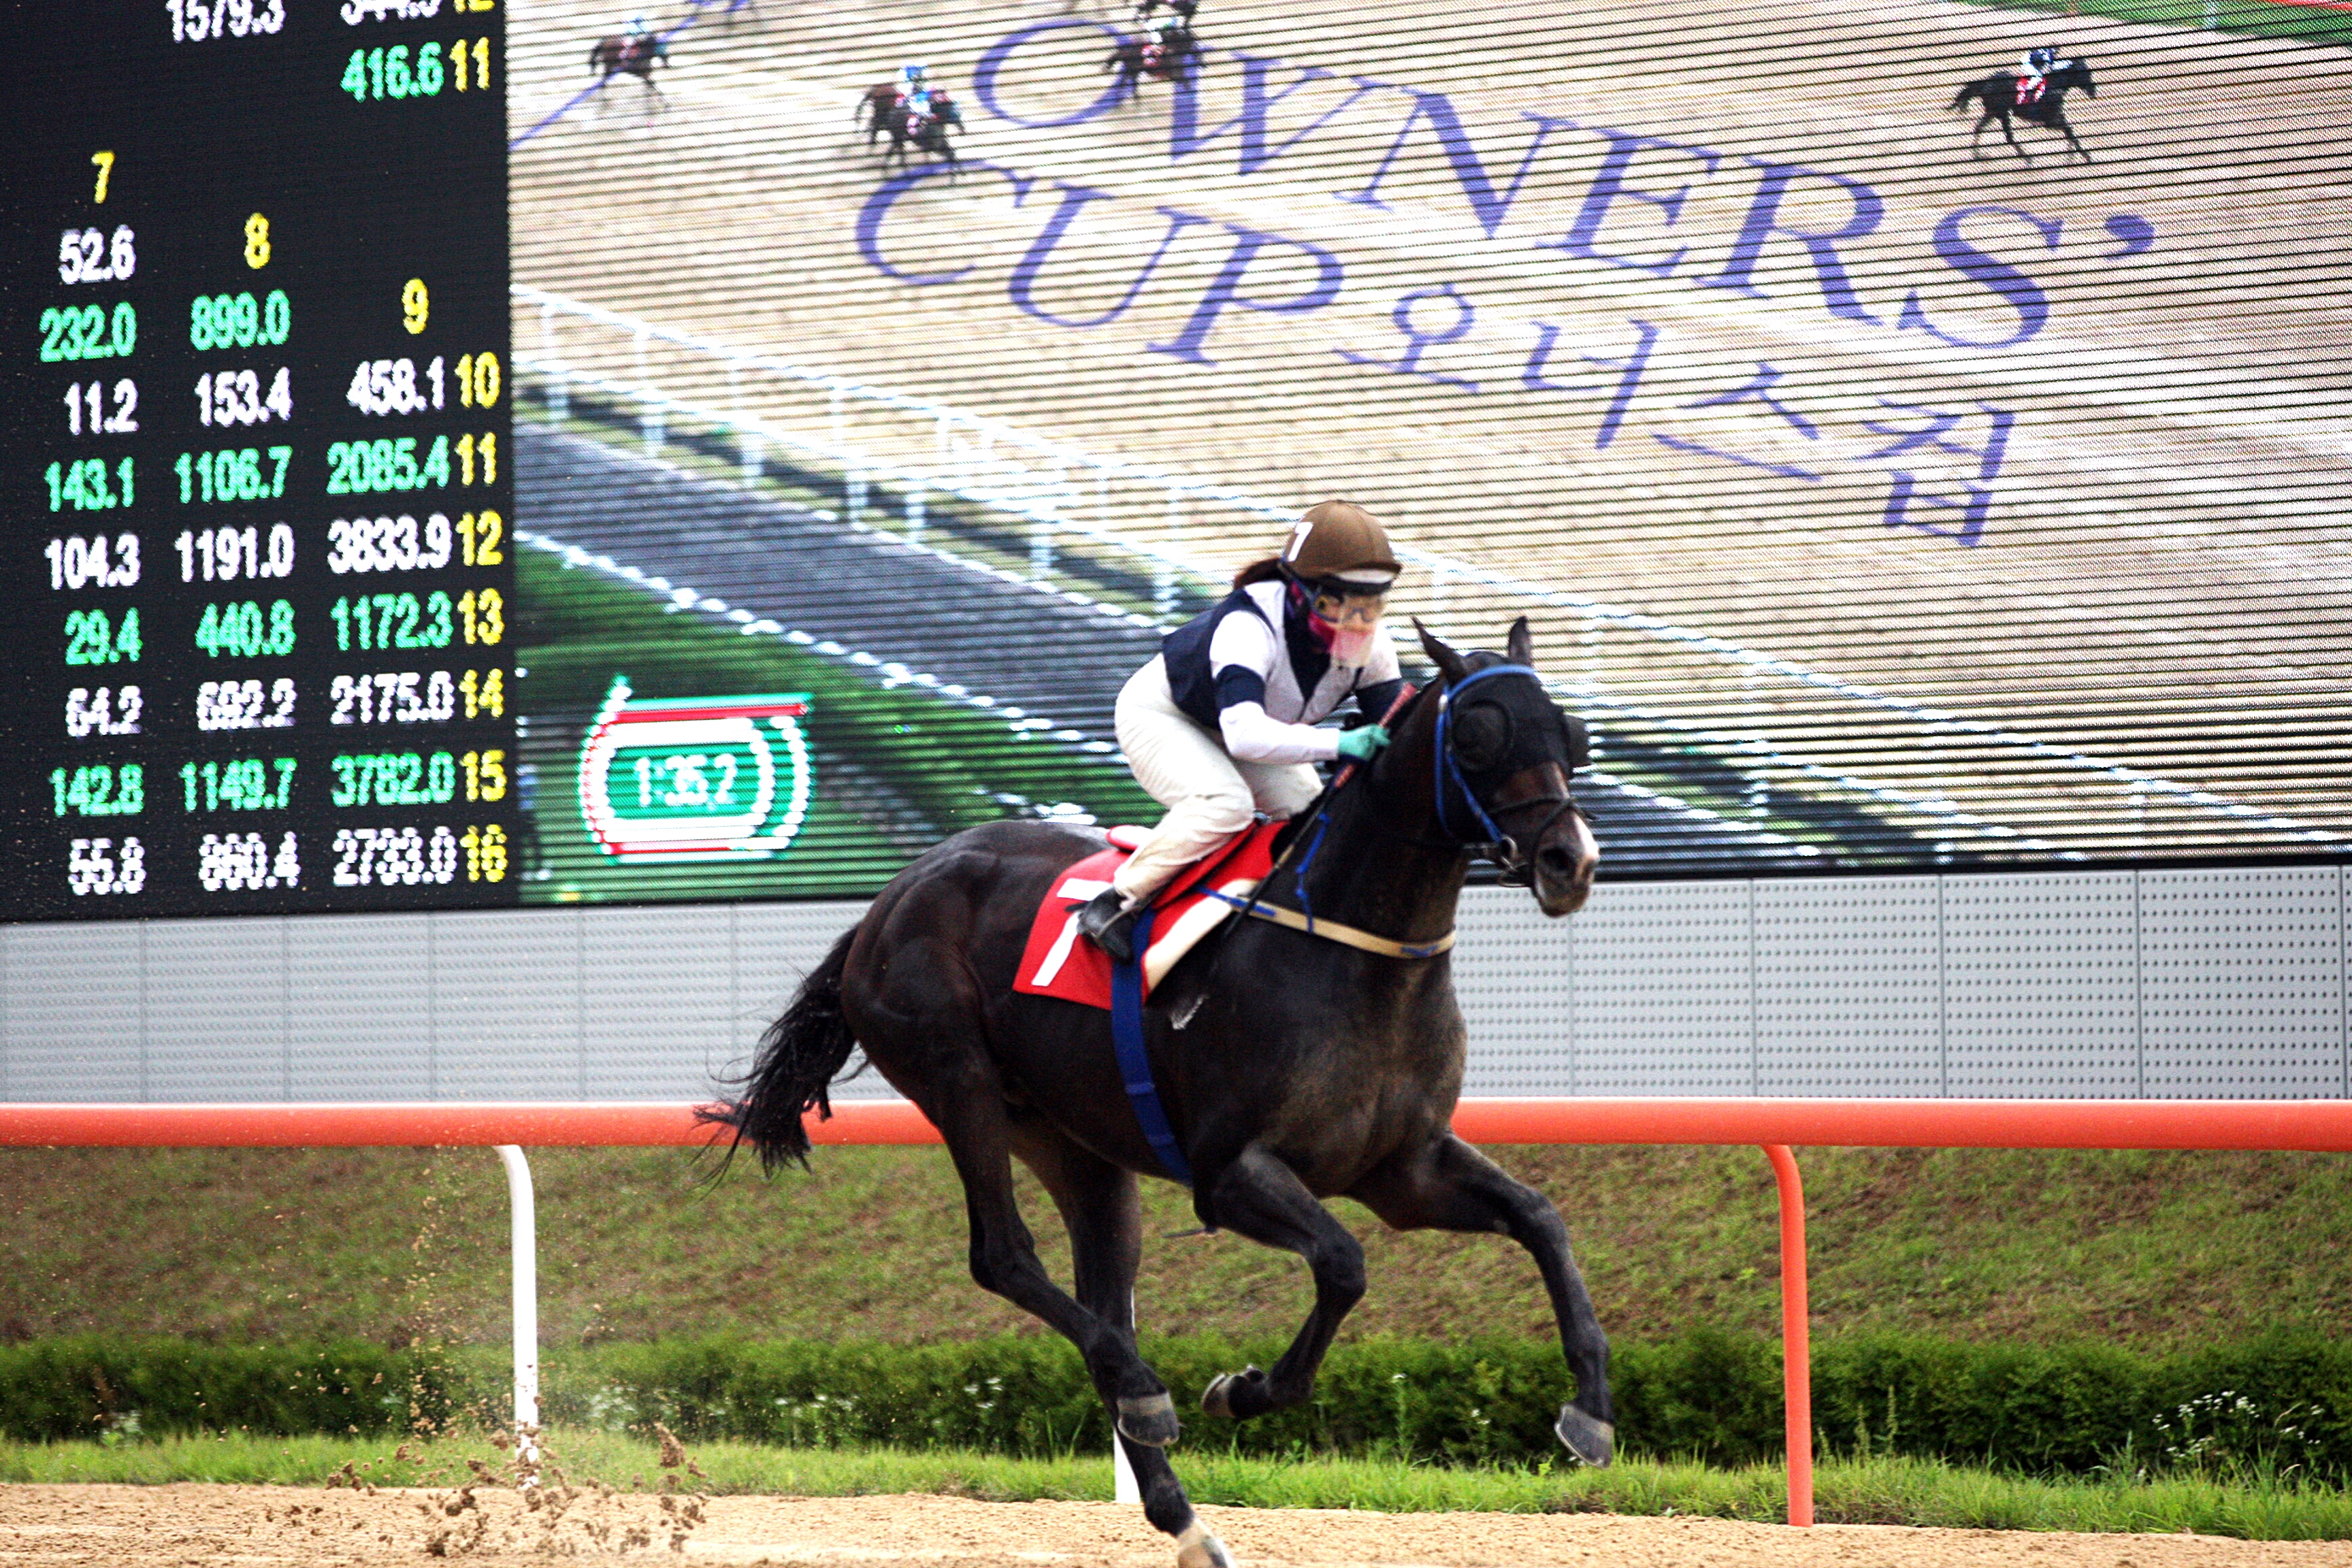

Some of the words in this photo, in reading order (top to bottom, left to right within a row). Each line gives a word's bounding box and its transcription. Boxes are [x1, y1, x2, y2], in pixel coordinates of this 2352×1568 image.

[340, 42, 444, 101] 416.6
[449, 37, 489, 91] 11
[92, 152, 114, 203] 7
[973, 20, 2156, 348] OWNERS'
[59, 225, 136, 284] 52.6
[244, 213, 271, 269] 8
[39, 301, 137, 362] 232.0
[191, 289, 291, 350] 899.0
[402, 278, 429, 334] 9
[855, 159, 1345, 366] CUP
[1331, 282, 2016, 548] 오너스컵
[64, 378, 139, 436] 11.2
[195, 367, 293, 427] 153.4
[346, 356, 444, 416] 458.1
[455, 352, 500, 408] 10
[44, 457, 134, 512] 143.1
[174, 446, 293, 504] 1106.7
[327, 435, 451, 494] 2085.4
[455, 432, 496, 485] 11
[44, 533, 141, 590] 104.3
[175, 523, 295, 583] 1191.0
[327, 513, 453, 574] 3833.9
[455, 510, 503, 566] 12
[65, 608, 142, 665] 29.4
[195, 600, 296, 657] 440.8
[331, 591, 453, 651] 1172.3
[457, 588, 504, 645] 13
[330, 671, 455, 725] 2175.0
[459, 668, 504, 719] 14
[50, 764, 144, 817] 142.8
[179, 757, 297, 812] 1149.7
[331, 751, 455, 806] 3782.0
[459, 750, 507, 802] 15
[460, 824, 508, 882] 16
